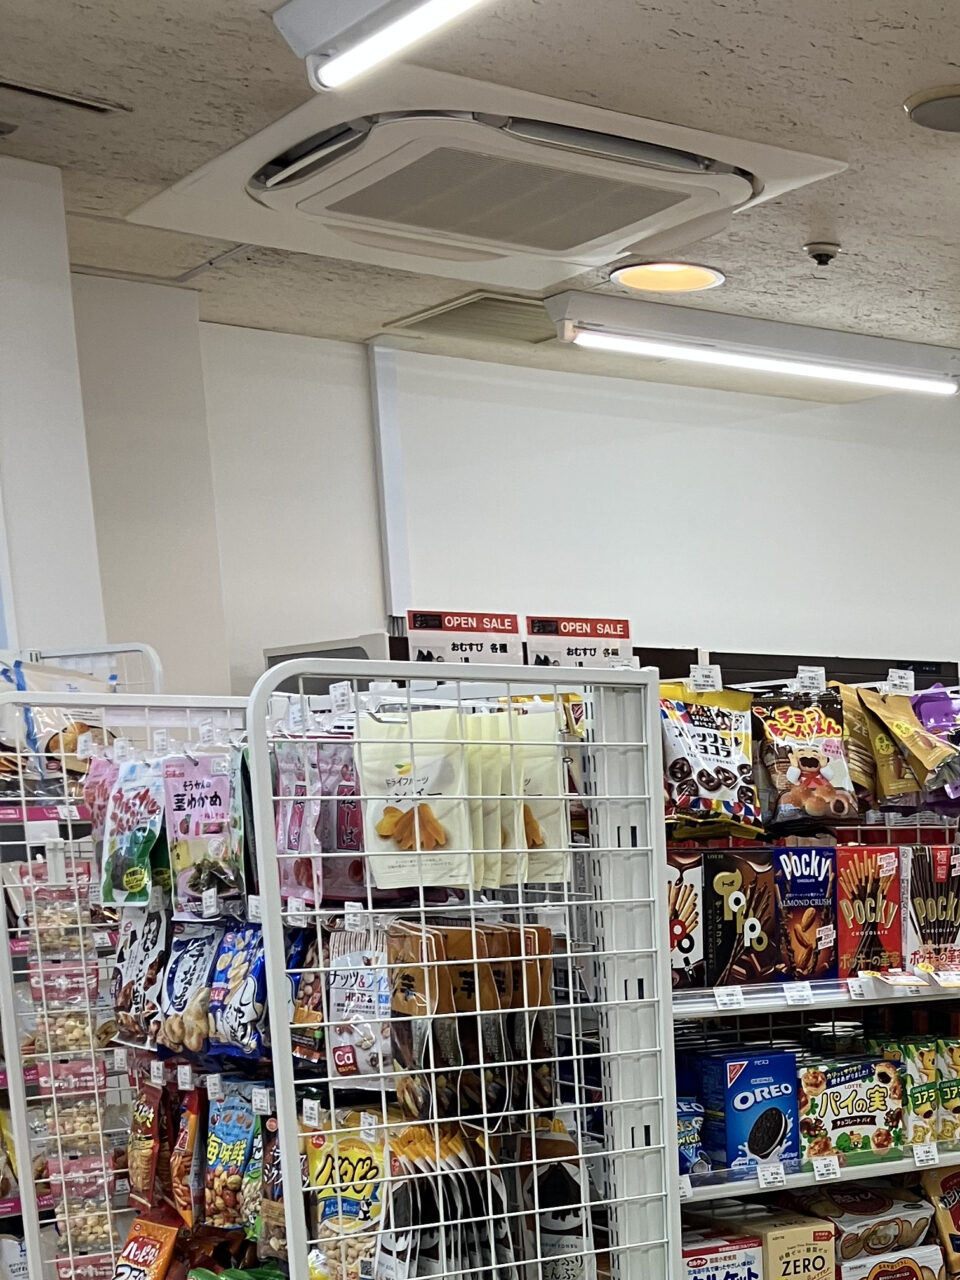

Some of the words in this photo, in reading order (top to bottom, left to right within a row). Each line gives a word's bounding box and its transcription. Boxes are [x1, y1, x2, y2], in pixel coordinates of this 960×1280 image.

[444, 616, 477, 628] OPEN
[483, 617, 512, 630] SALE
[560, 621, 591, 633] OPEN
[596, 623, 624, 635] SALE
[451, 642, 484, 653] おむすび
[566, 647, 597, 657] おむすび
[173, 793, 223, 812] 茎わかめ
[779, 898, 809, 907] ALMOND
[809, 897, 832, 906] CRUSH
[335, 1049, 354, 1066] Ca
[733, 1083, 792, 1111] OREO
[819, 1085, 889, 1118] パイの実
[206, 1133, 247, 1166] 海味鮮
[782, 1256, 826, 1276] ZERO
